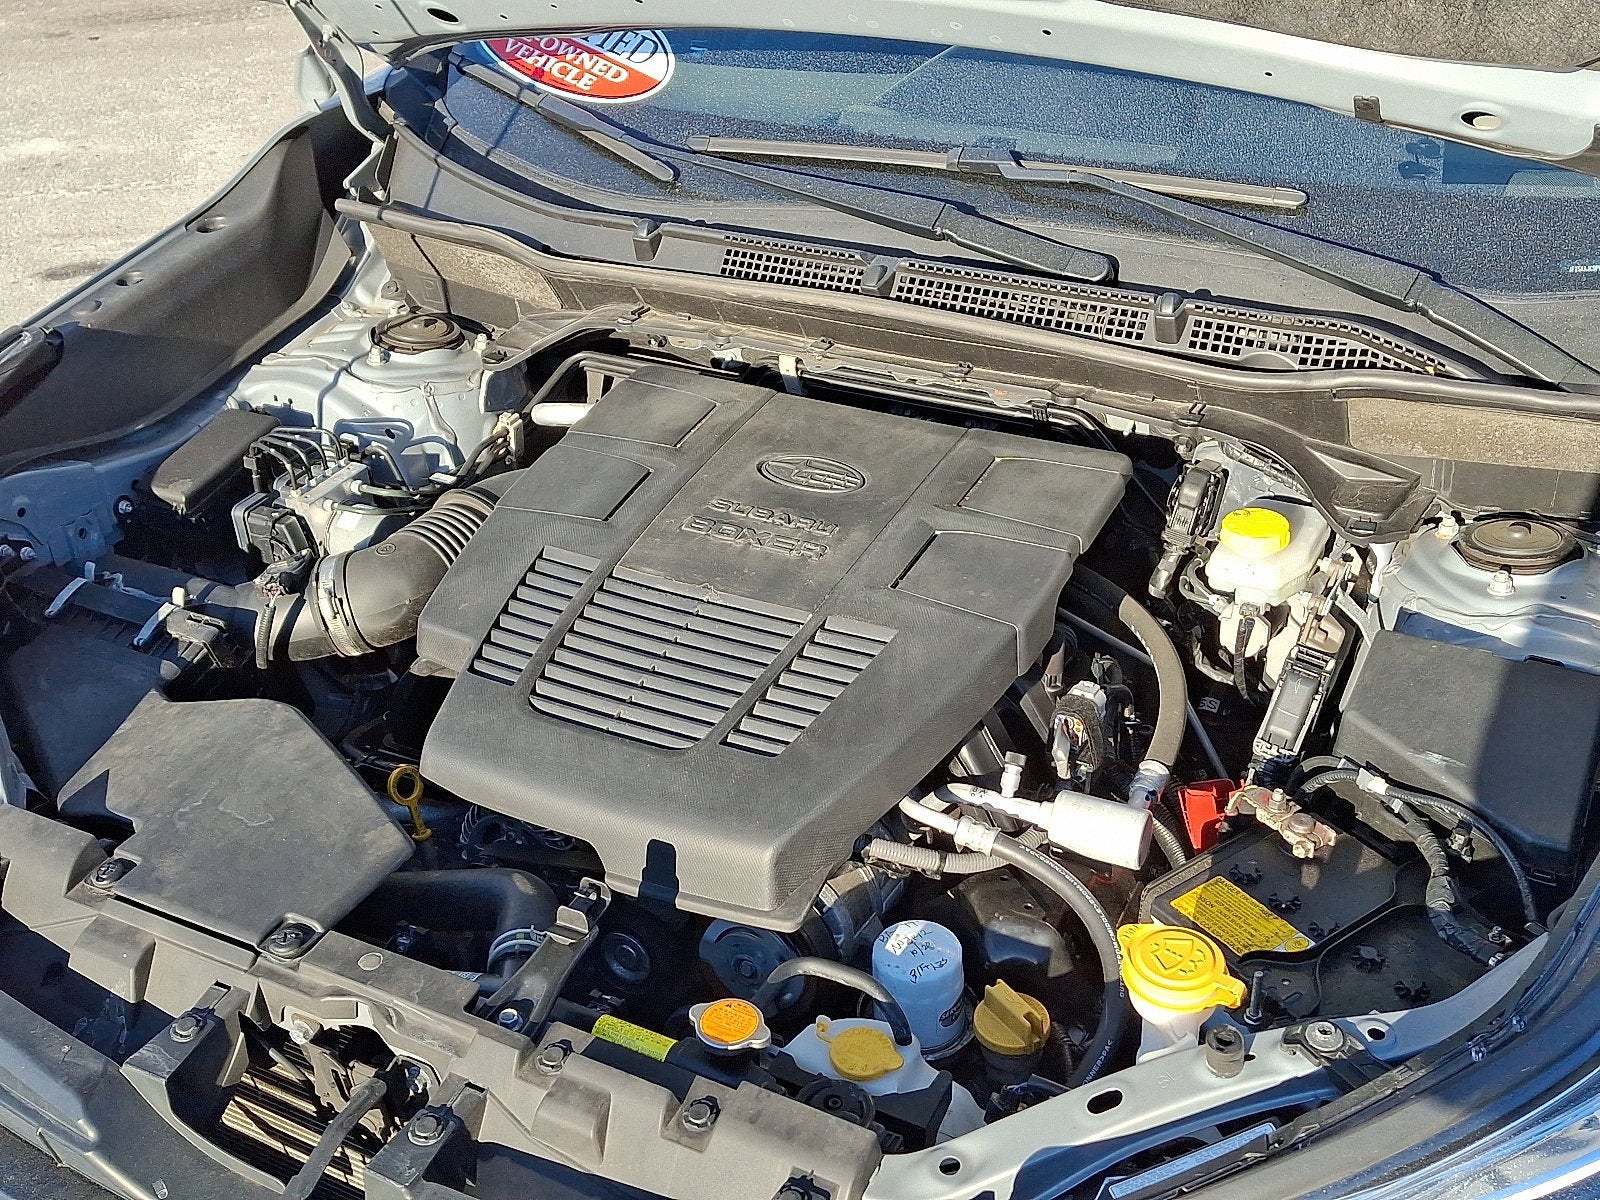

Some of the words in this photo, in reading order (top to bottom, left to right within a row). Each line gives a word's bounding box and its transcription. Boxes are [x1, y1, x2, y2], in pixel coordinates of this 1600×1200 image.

[505, 38, 599, 91] VEHICLE
[581, 30, 659, 64] IED
[707, 498, 840, 537] SUBARU
[681, 515, 830, 561] BOXER
[1190, 891, 1216, 908] POISON
[1214, 877, 1241, 895] DANGER
